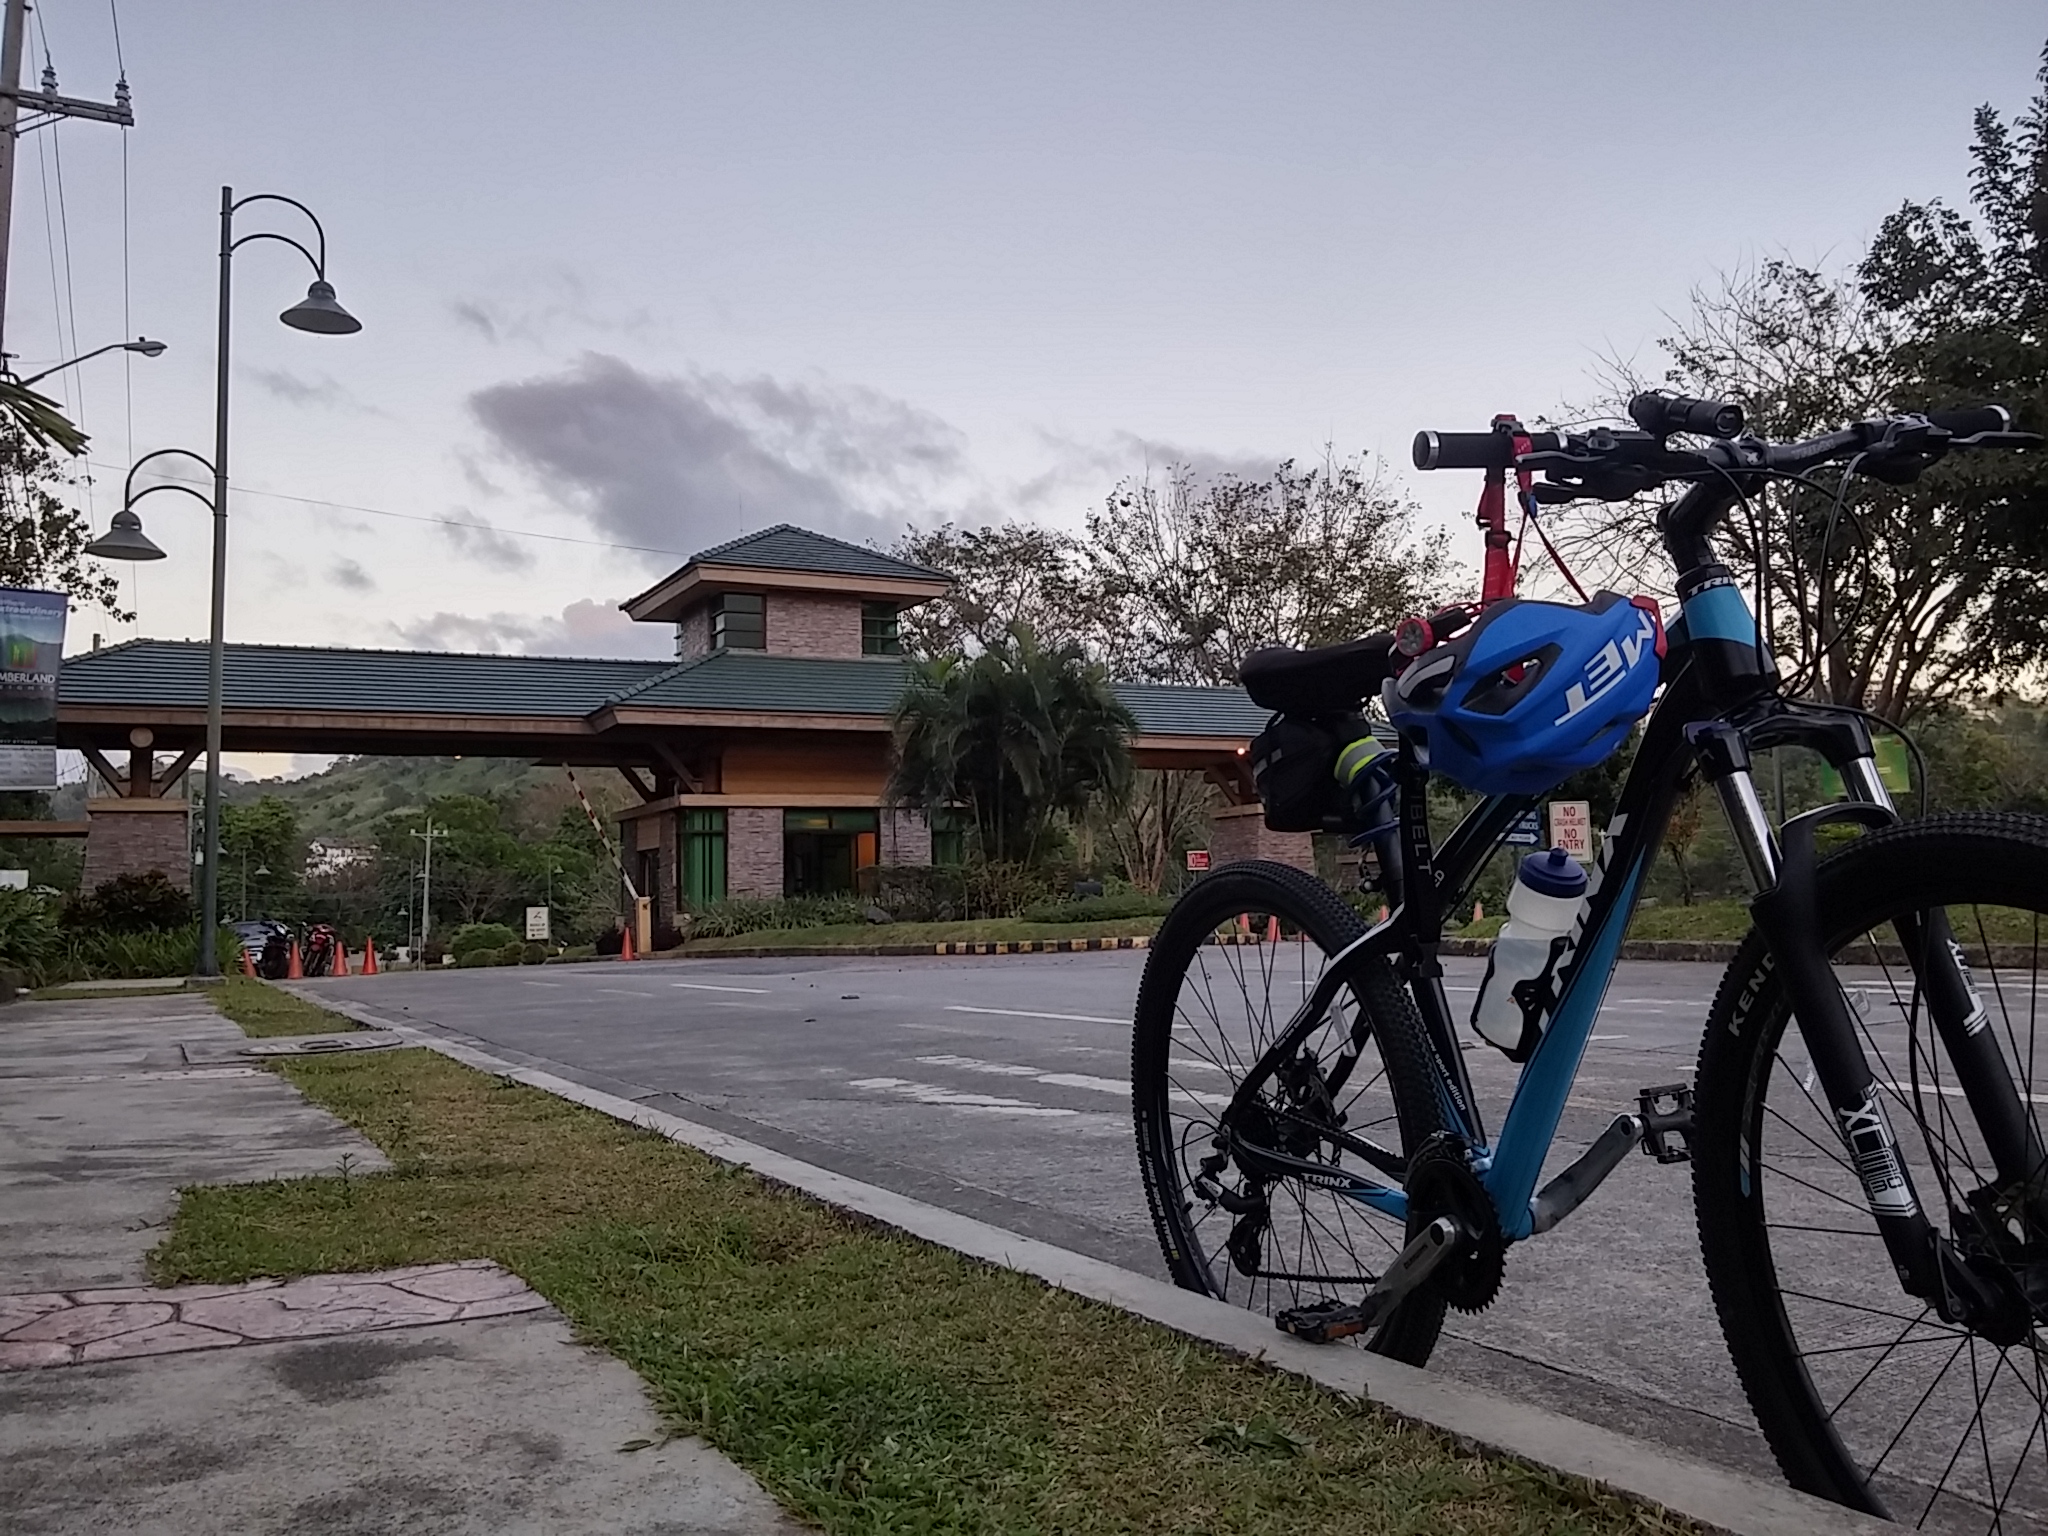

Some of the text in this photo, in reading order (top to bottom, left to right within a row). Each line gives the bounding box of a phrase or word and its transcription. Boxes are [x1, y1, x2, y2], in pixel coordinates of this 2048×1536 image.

[1554, 609, 1656, 727] MET
[1563, 806, 1576, 817] NO
[1557, 839, 1585, 850] ENTRY
[1564, 828, 1577, 839] NO
[1728, 952, 1775, 1037] KEND
[1435, 1053, 1450, 1078] sport
[1446, 1079, 1466, 1111] edition
[1301, 1172, 1352, 1188] TRINX
[1152, 1185, 1165, 1217] BLOCK
